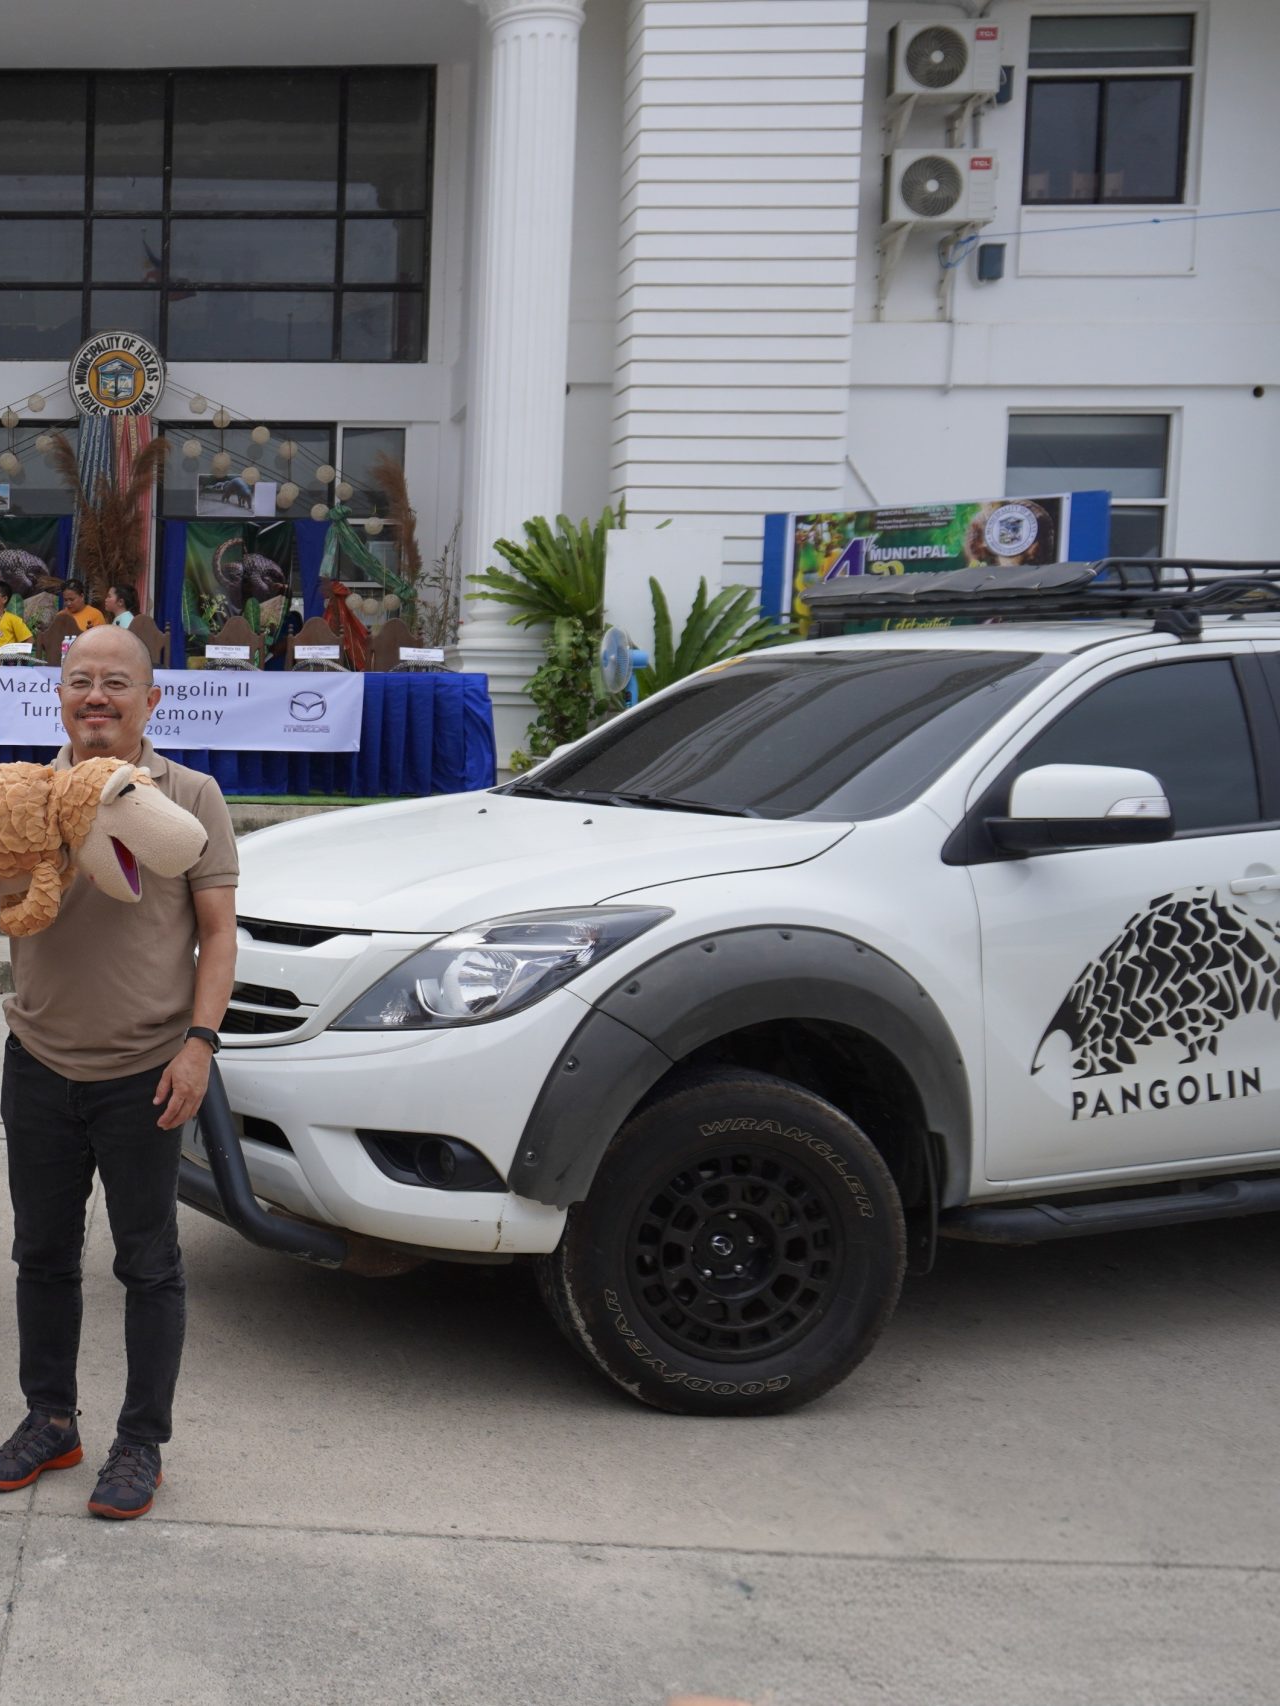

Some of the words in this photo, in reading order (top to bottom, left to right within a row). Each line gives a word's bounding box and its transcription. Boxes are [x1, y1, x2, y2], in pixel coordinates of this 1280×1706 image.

[75, 335, 121, 385] MUNICIPALITY
[122, 337, 136, 351] OF
[135, 345, 159, 382] ROXAS
[78, 390, 106, 415] ROXAS
[870, 545, 950, 562] MUNICIPAL
[153, 680, 227, 701] ngolin
[237, 682, 249, 697] II
[146, 724, 181, 736] 2024
[1072, 1066, 1262, 1121] PANGOLIN
[699, 1117, 875, 1219] WRANGLER
